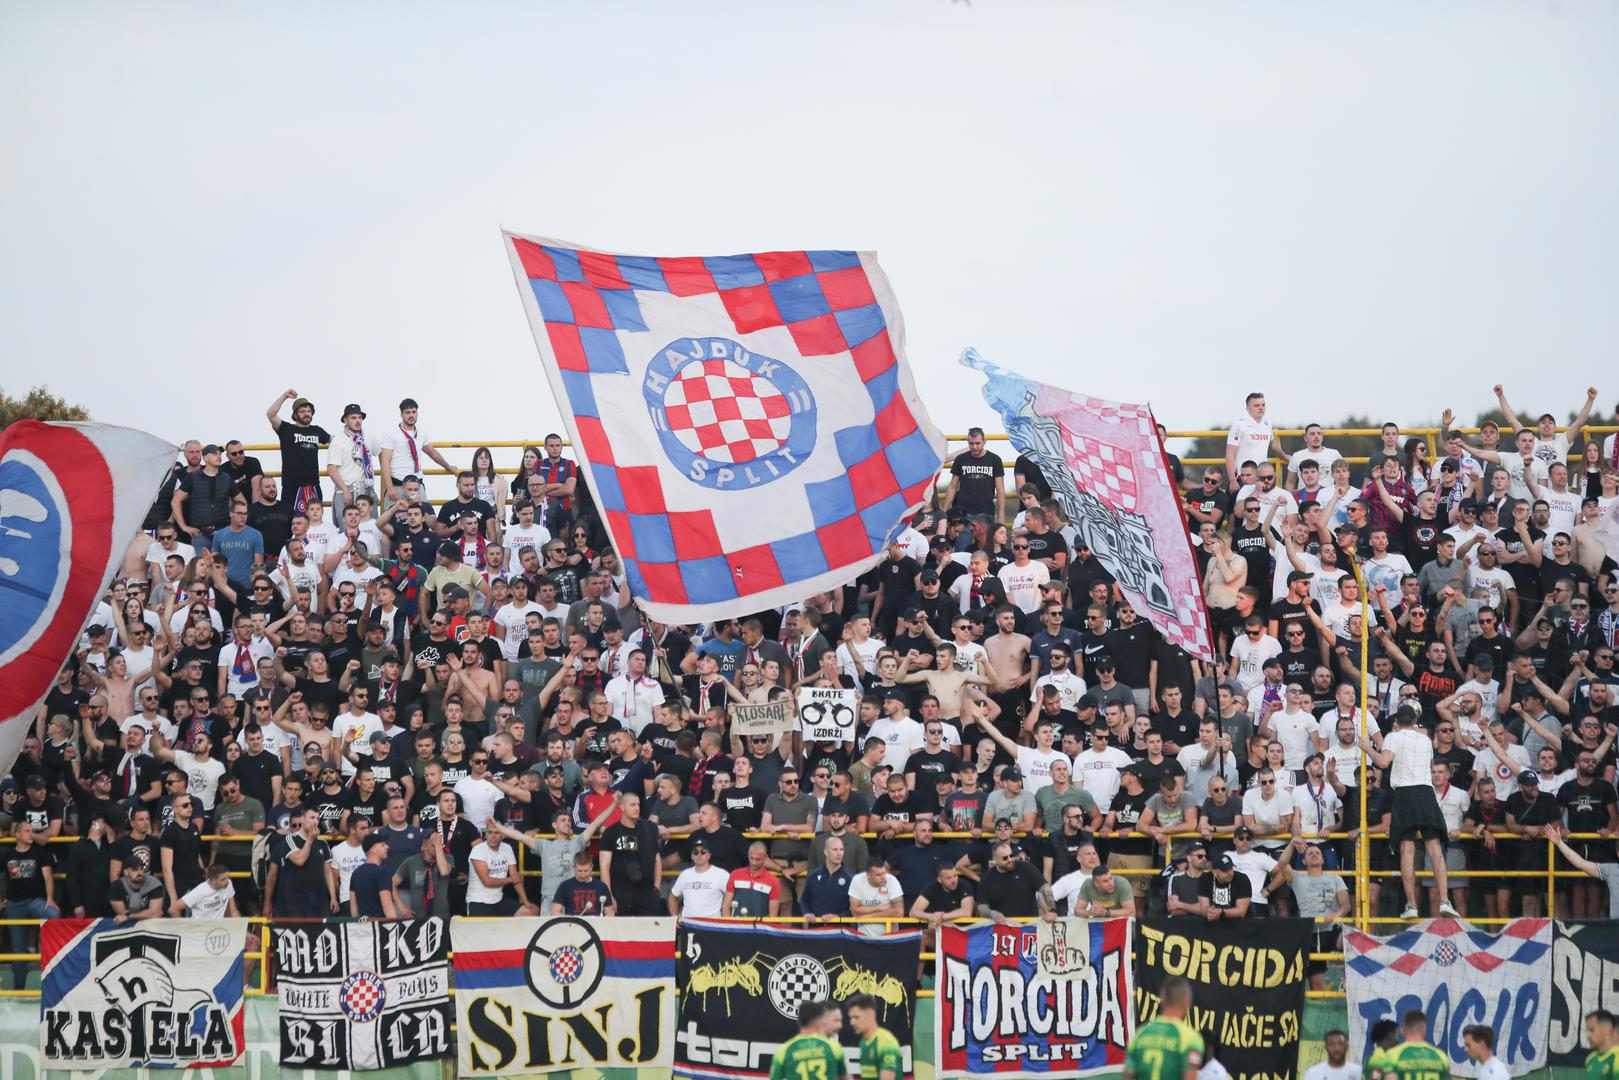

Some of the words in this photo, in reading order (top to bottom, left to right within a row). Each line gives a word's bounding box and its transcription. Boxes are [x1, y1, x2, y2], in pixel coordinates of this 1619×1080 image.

[646, 340, 781, 395] HAJDUK
[690, 447, 797, 487] SPLIT
[962, 465, 993, 478] TORCIDA
[813, 727, 843, 739] IZDRŽI
[776, 957, 822, 977] HAJDUK
[1141, 924, 1304, 988] TORCIDA
[285, 988, 331, 1009] WHITE
[398, 976, 439, 999] BOYS
[344, 973, 385, 990] HAJDUK
[347, 1009, 379, 1021] SPLIT
[945, 950, 1126, 1050] TORCIDA
[467, 985, 666, 1072] SINJ
[1358, 981, 1540, 1065] TOGIR
[983, 1042, 1088, 1061] SPLIT
